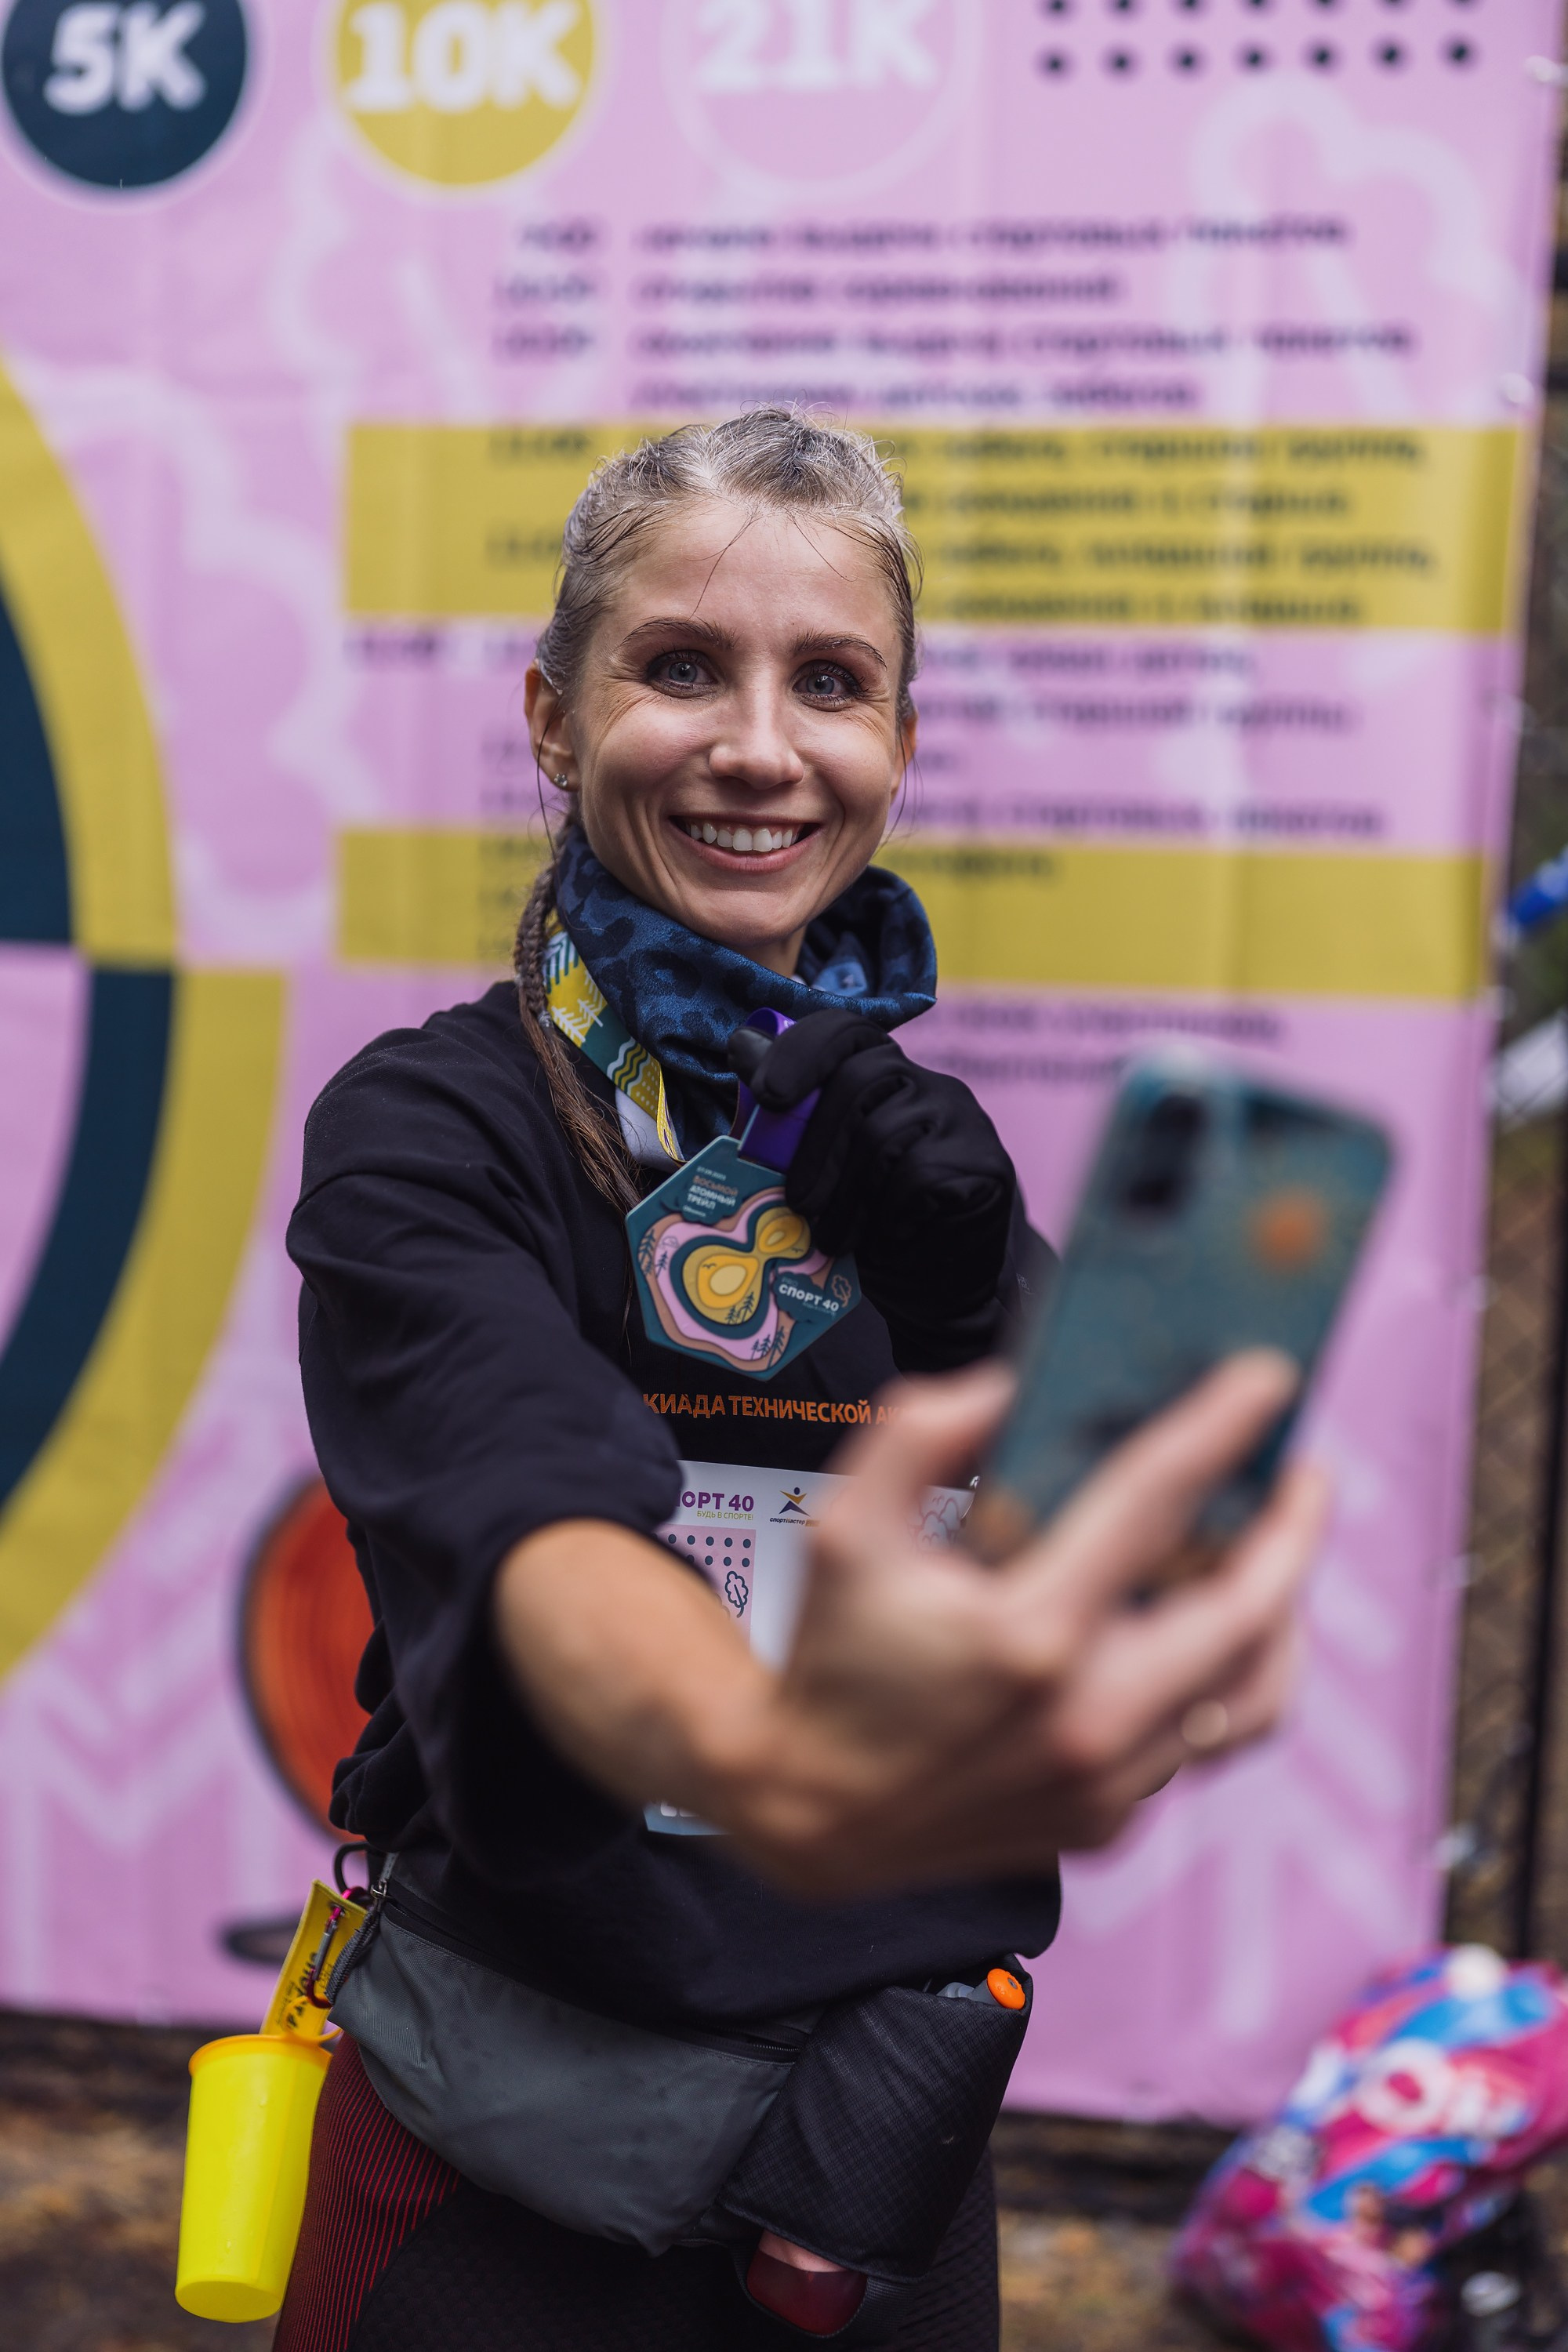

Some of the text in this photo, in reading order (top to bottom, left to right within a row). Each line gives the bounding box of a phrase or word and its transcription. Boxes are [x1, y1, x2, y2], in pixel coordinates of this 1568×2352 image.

[45, 2, 205, 115] 5K
[347, 1, 582, 114] 10K
[695, 0, 938, 91] 21K
[689, 1185, 736, 1207] АТОМНЫЙ
[779, 1283, 822, 1305] СПОРТ
[822, 1298, 840, 1312] 40
[728, 1396, 872, 1424] ТЕХНИЧЕСКОЙ
[723, 1512, 753, 1521] СПОРТЕ!
[728, 1494, 754, 1512] 40
